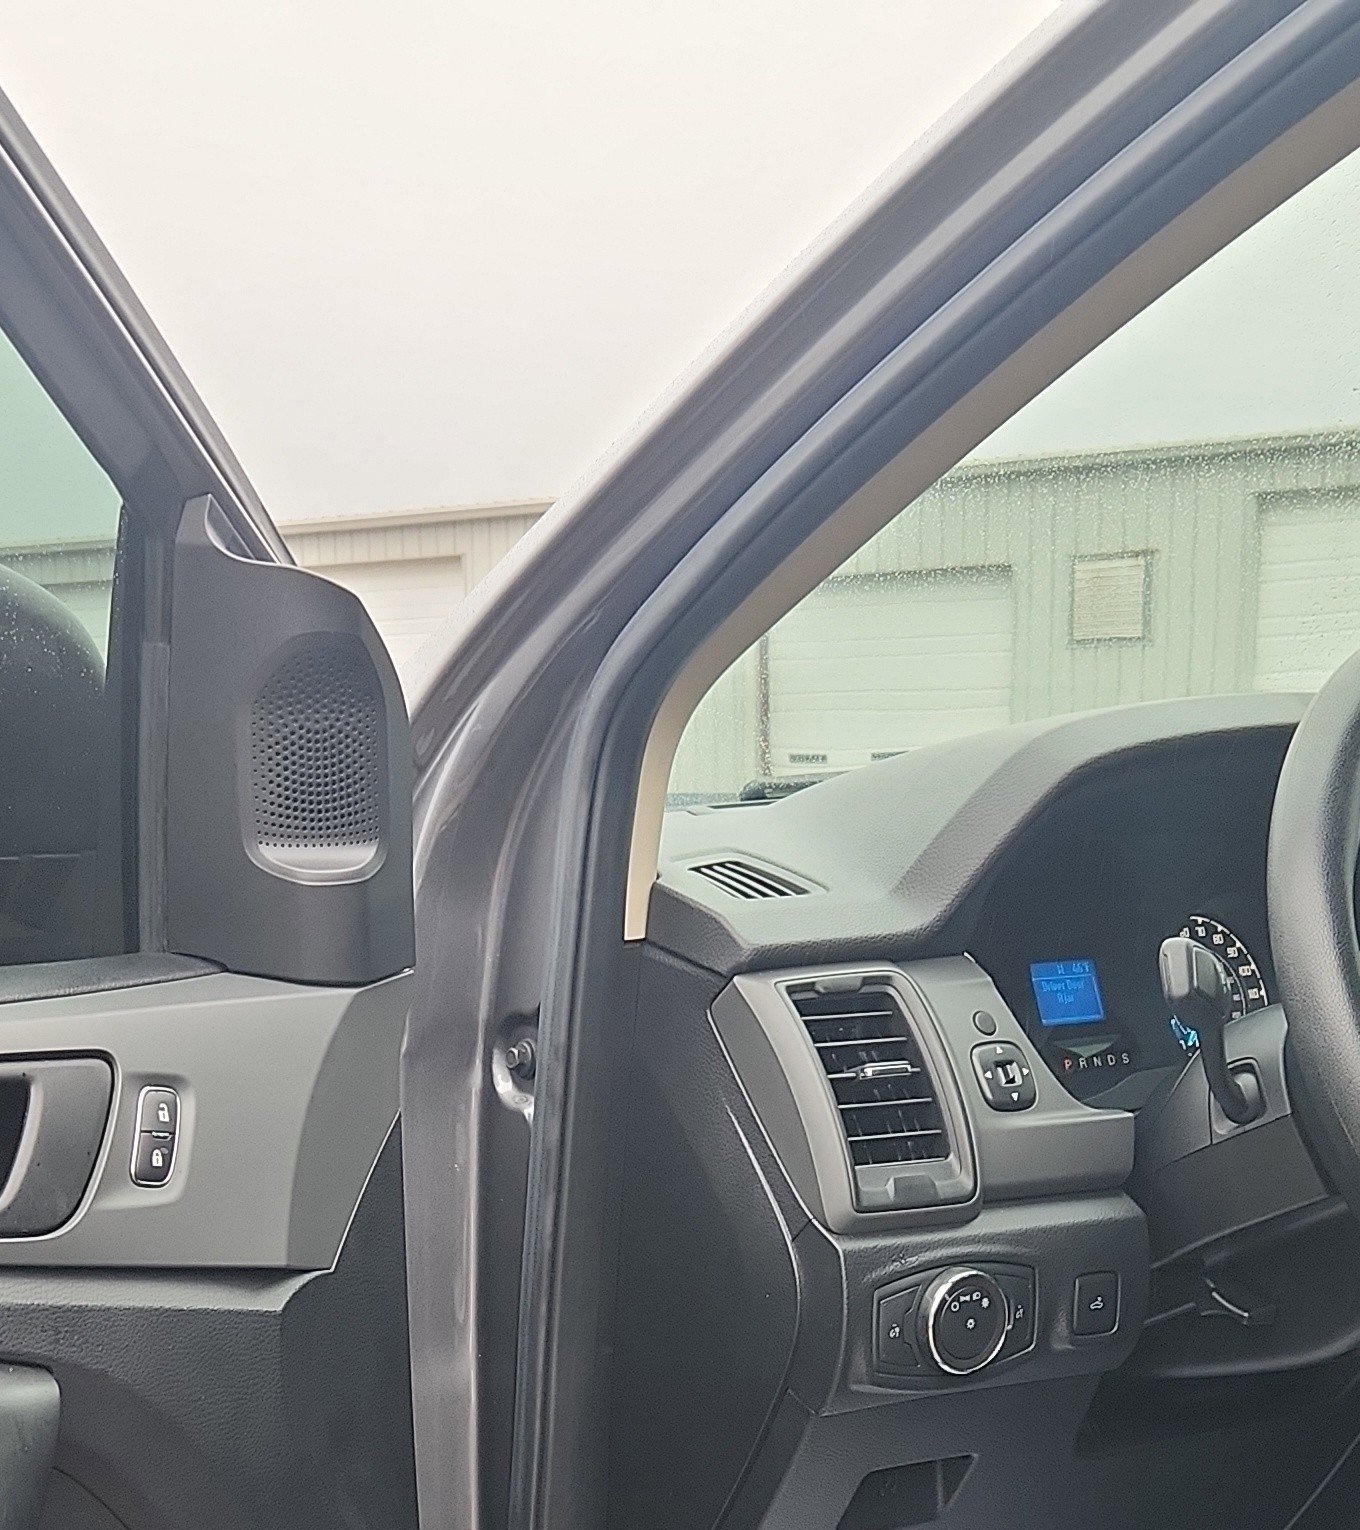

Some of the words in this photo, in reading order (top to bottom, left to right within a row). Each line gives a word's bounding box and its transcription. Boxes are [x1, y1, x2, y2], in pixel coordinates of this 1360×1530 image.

[1092, 1056, 1102, 1067] N
[1107, 1054, 1117, 1066] D
[1121, 1052, 1130, 1064] S
